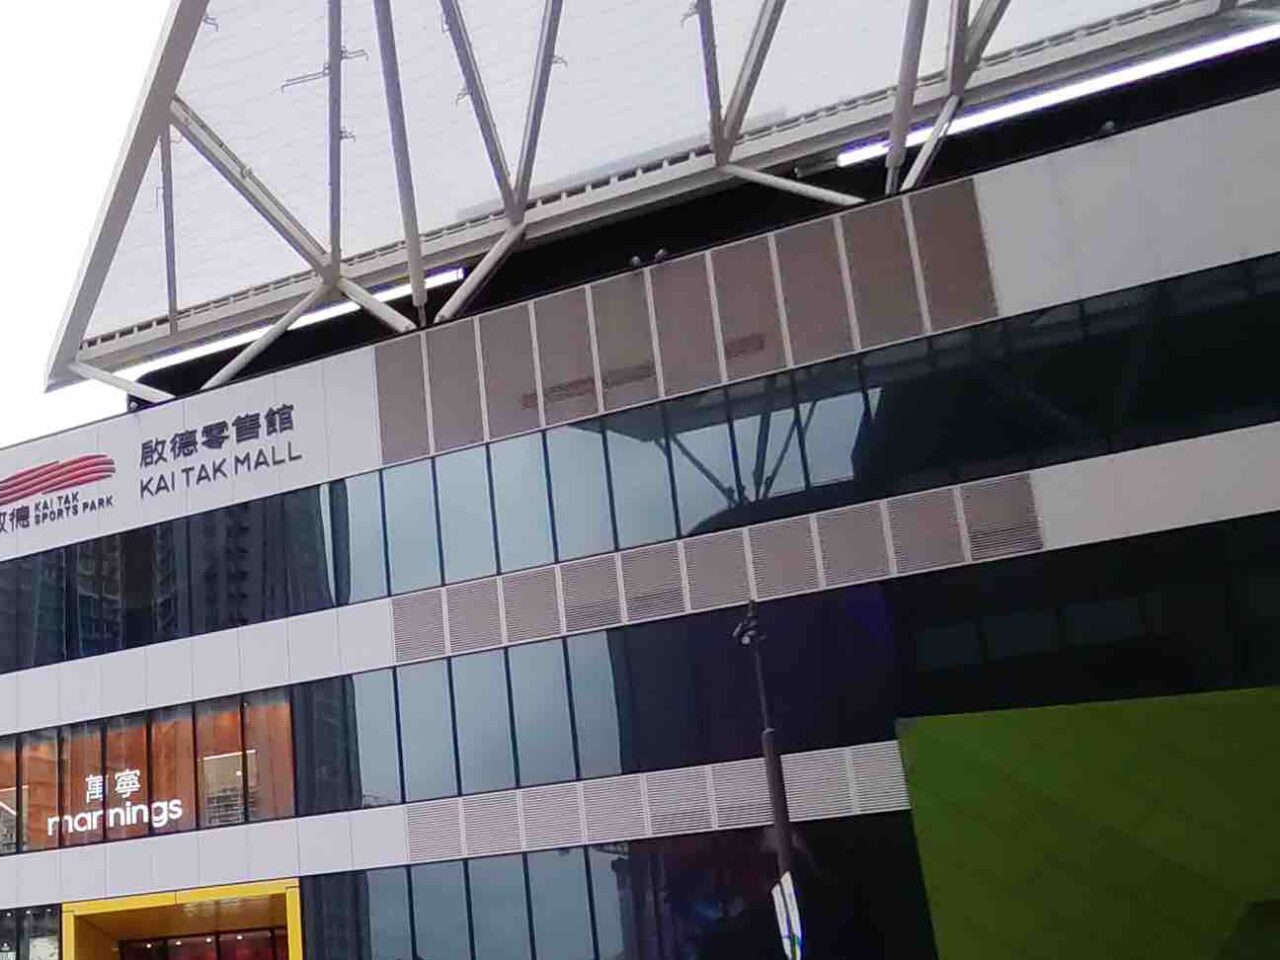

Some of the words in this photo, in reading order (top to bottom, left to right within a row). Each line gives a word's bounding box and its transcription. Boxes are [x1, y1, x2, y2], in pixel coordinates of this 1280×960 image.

[140, 403, 295, 468] 啟德零售館
[140, 472, 175, 498] KAI
[181, 458, 228, 487] TAK
[234, 441, 302, 475] MALL
[34, 498, 53, 512] KAI
[57, 491, 79, 506] TAK
[34, 504, 79, 525] SPORTS
[83, 496, 113, 513] PARK
[47, 799, 183, 836] mannings
